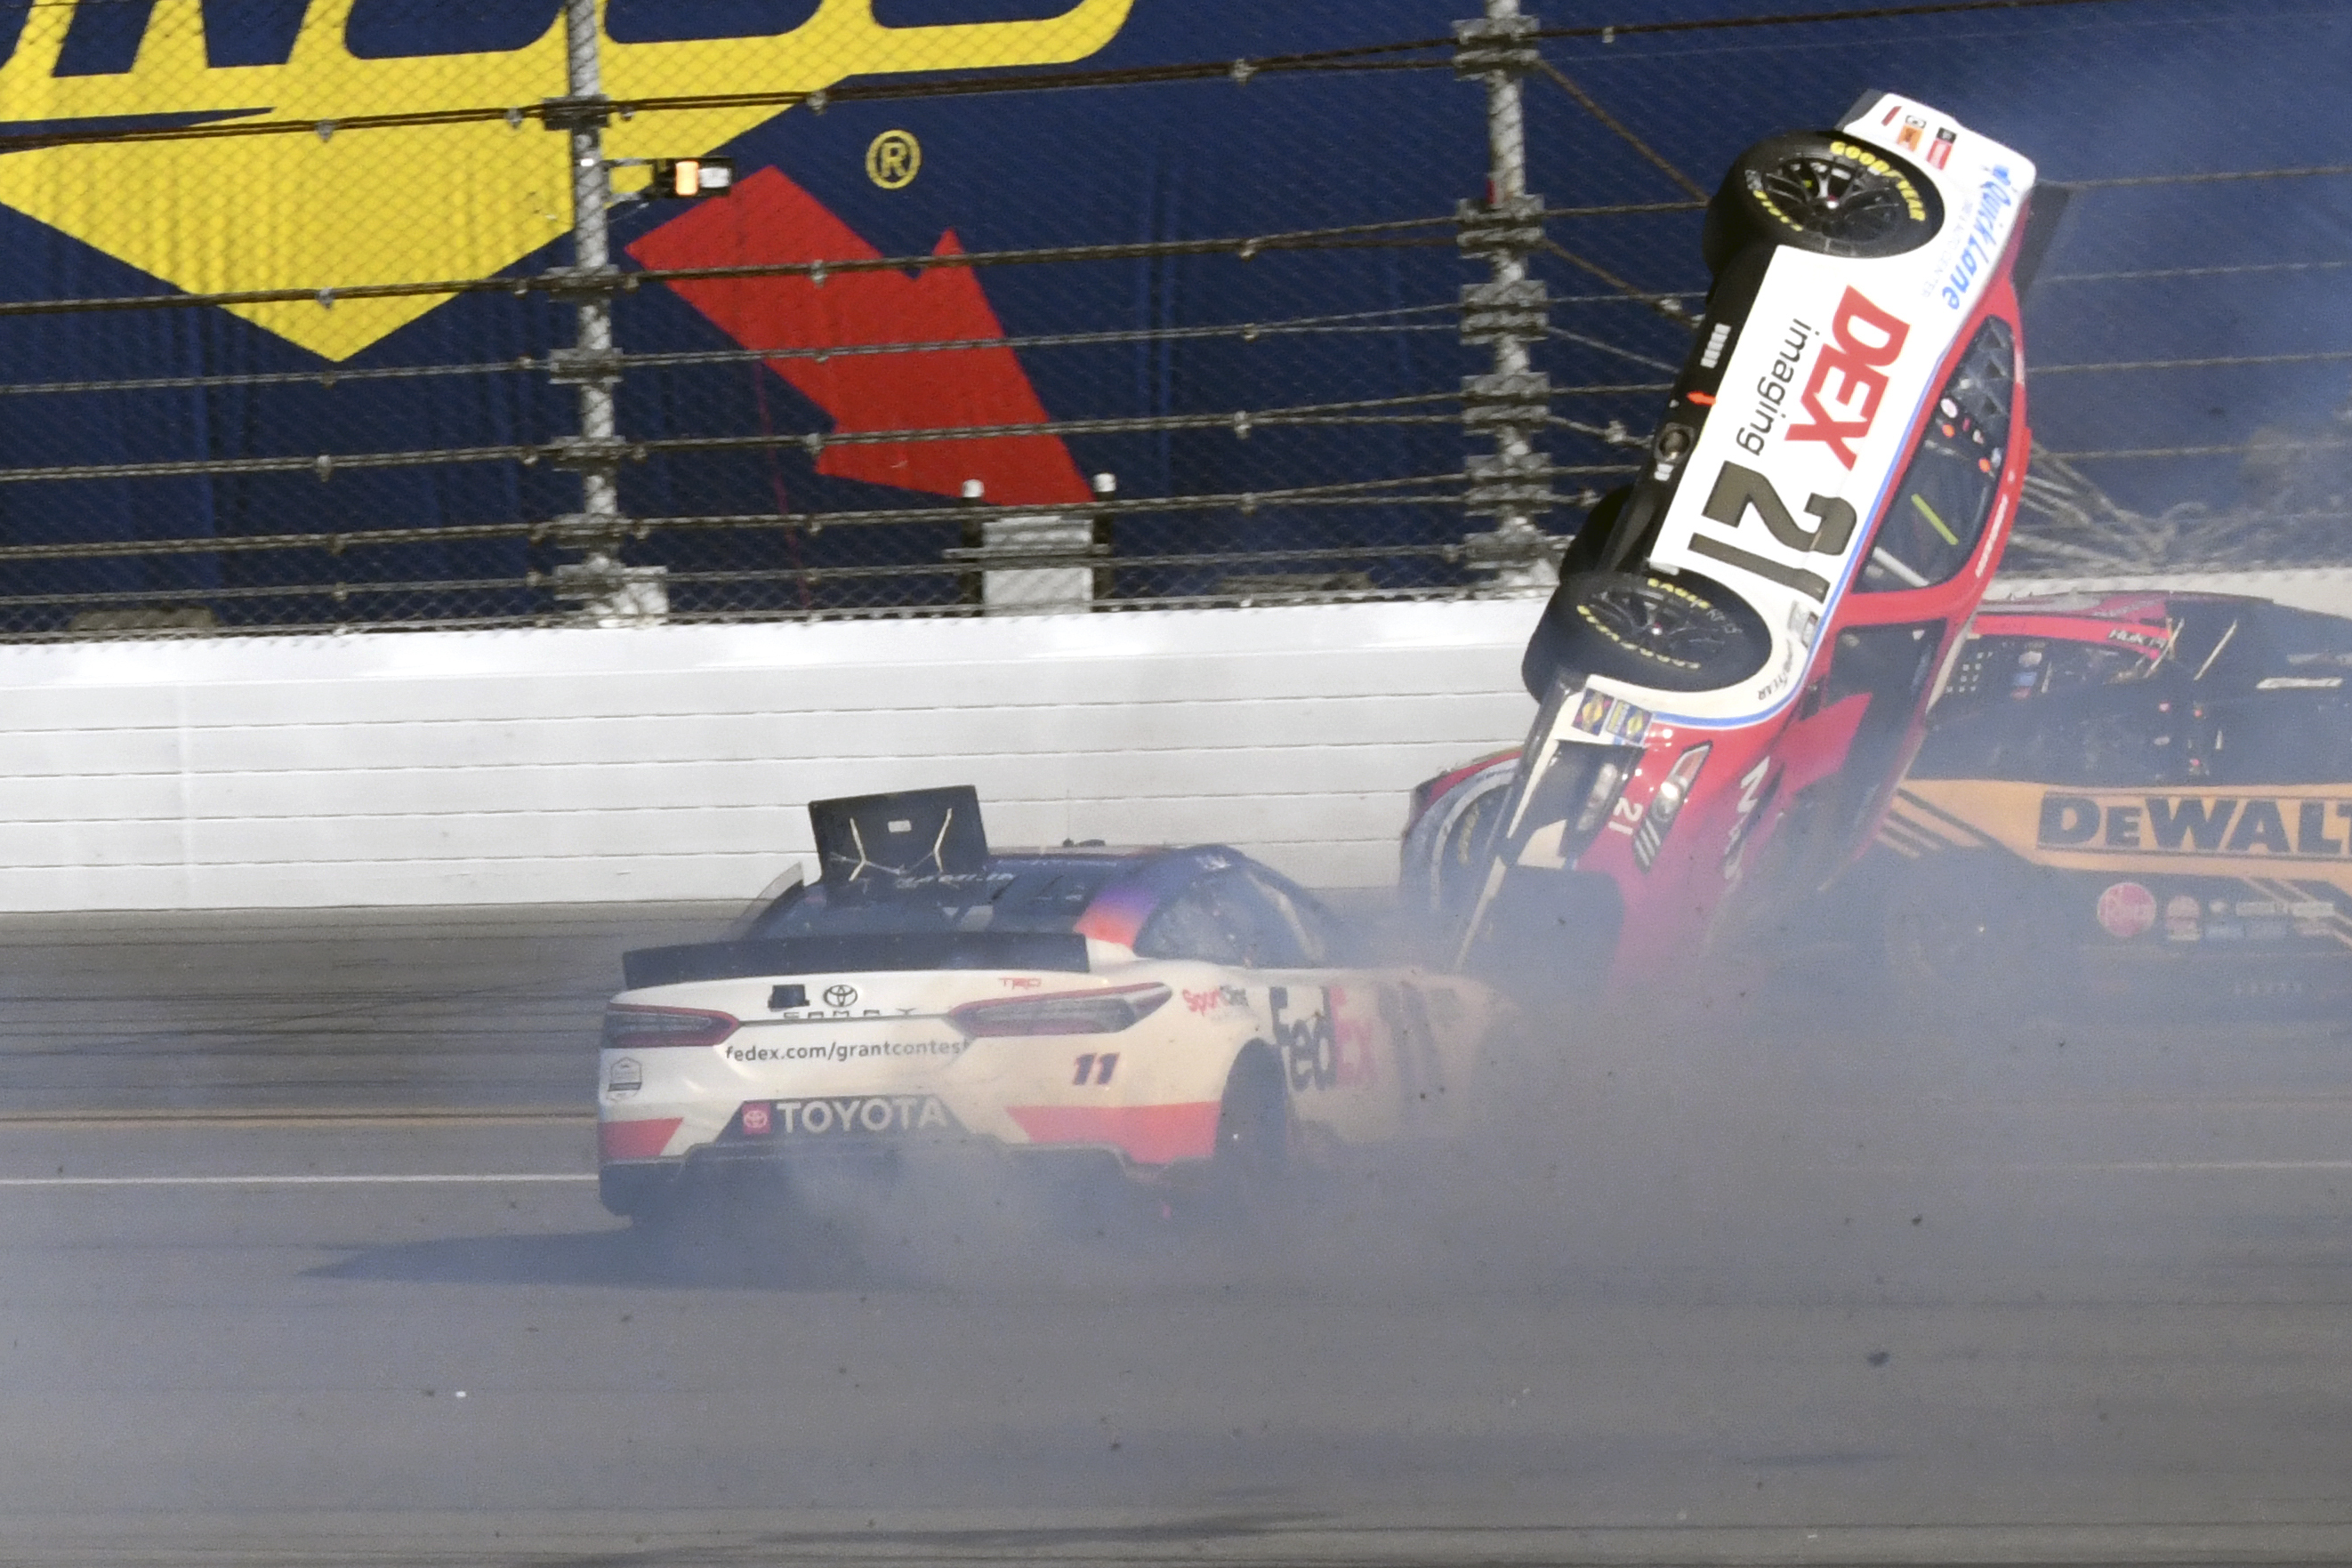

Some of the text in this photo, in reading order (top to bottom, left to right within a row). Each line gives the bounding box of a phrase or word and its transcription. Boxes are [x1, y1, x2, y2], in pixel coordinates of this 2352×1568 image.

[1942, 181, 2012, 310] Quick Lane
[1736, 318, 1820, 455] imaging
[1784, 285, 1911, 471] DEX
[1687, 460, 1857, 604] 21
[1608, 797, 1643, 835] 21
[777, 1097, 947, 1134] TOYOTA
[1072, 1051, 1120, 1085] 11
